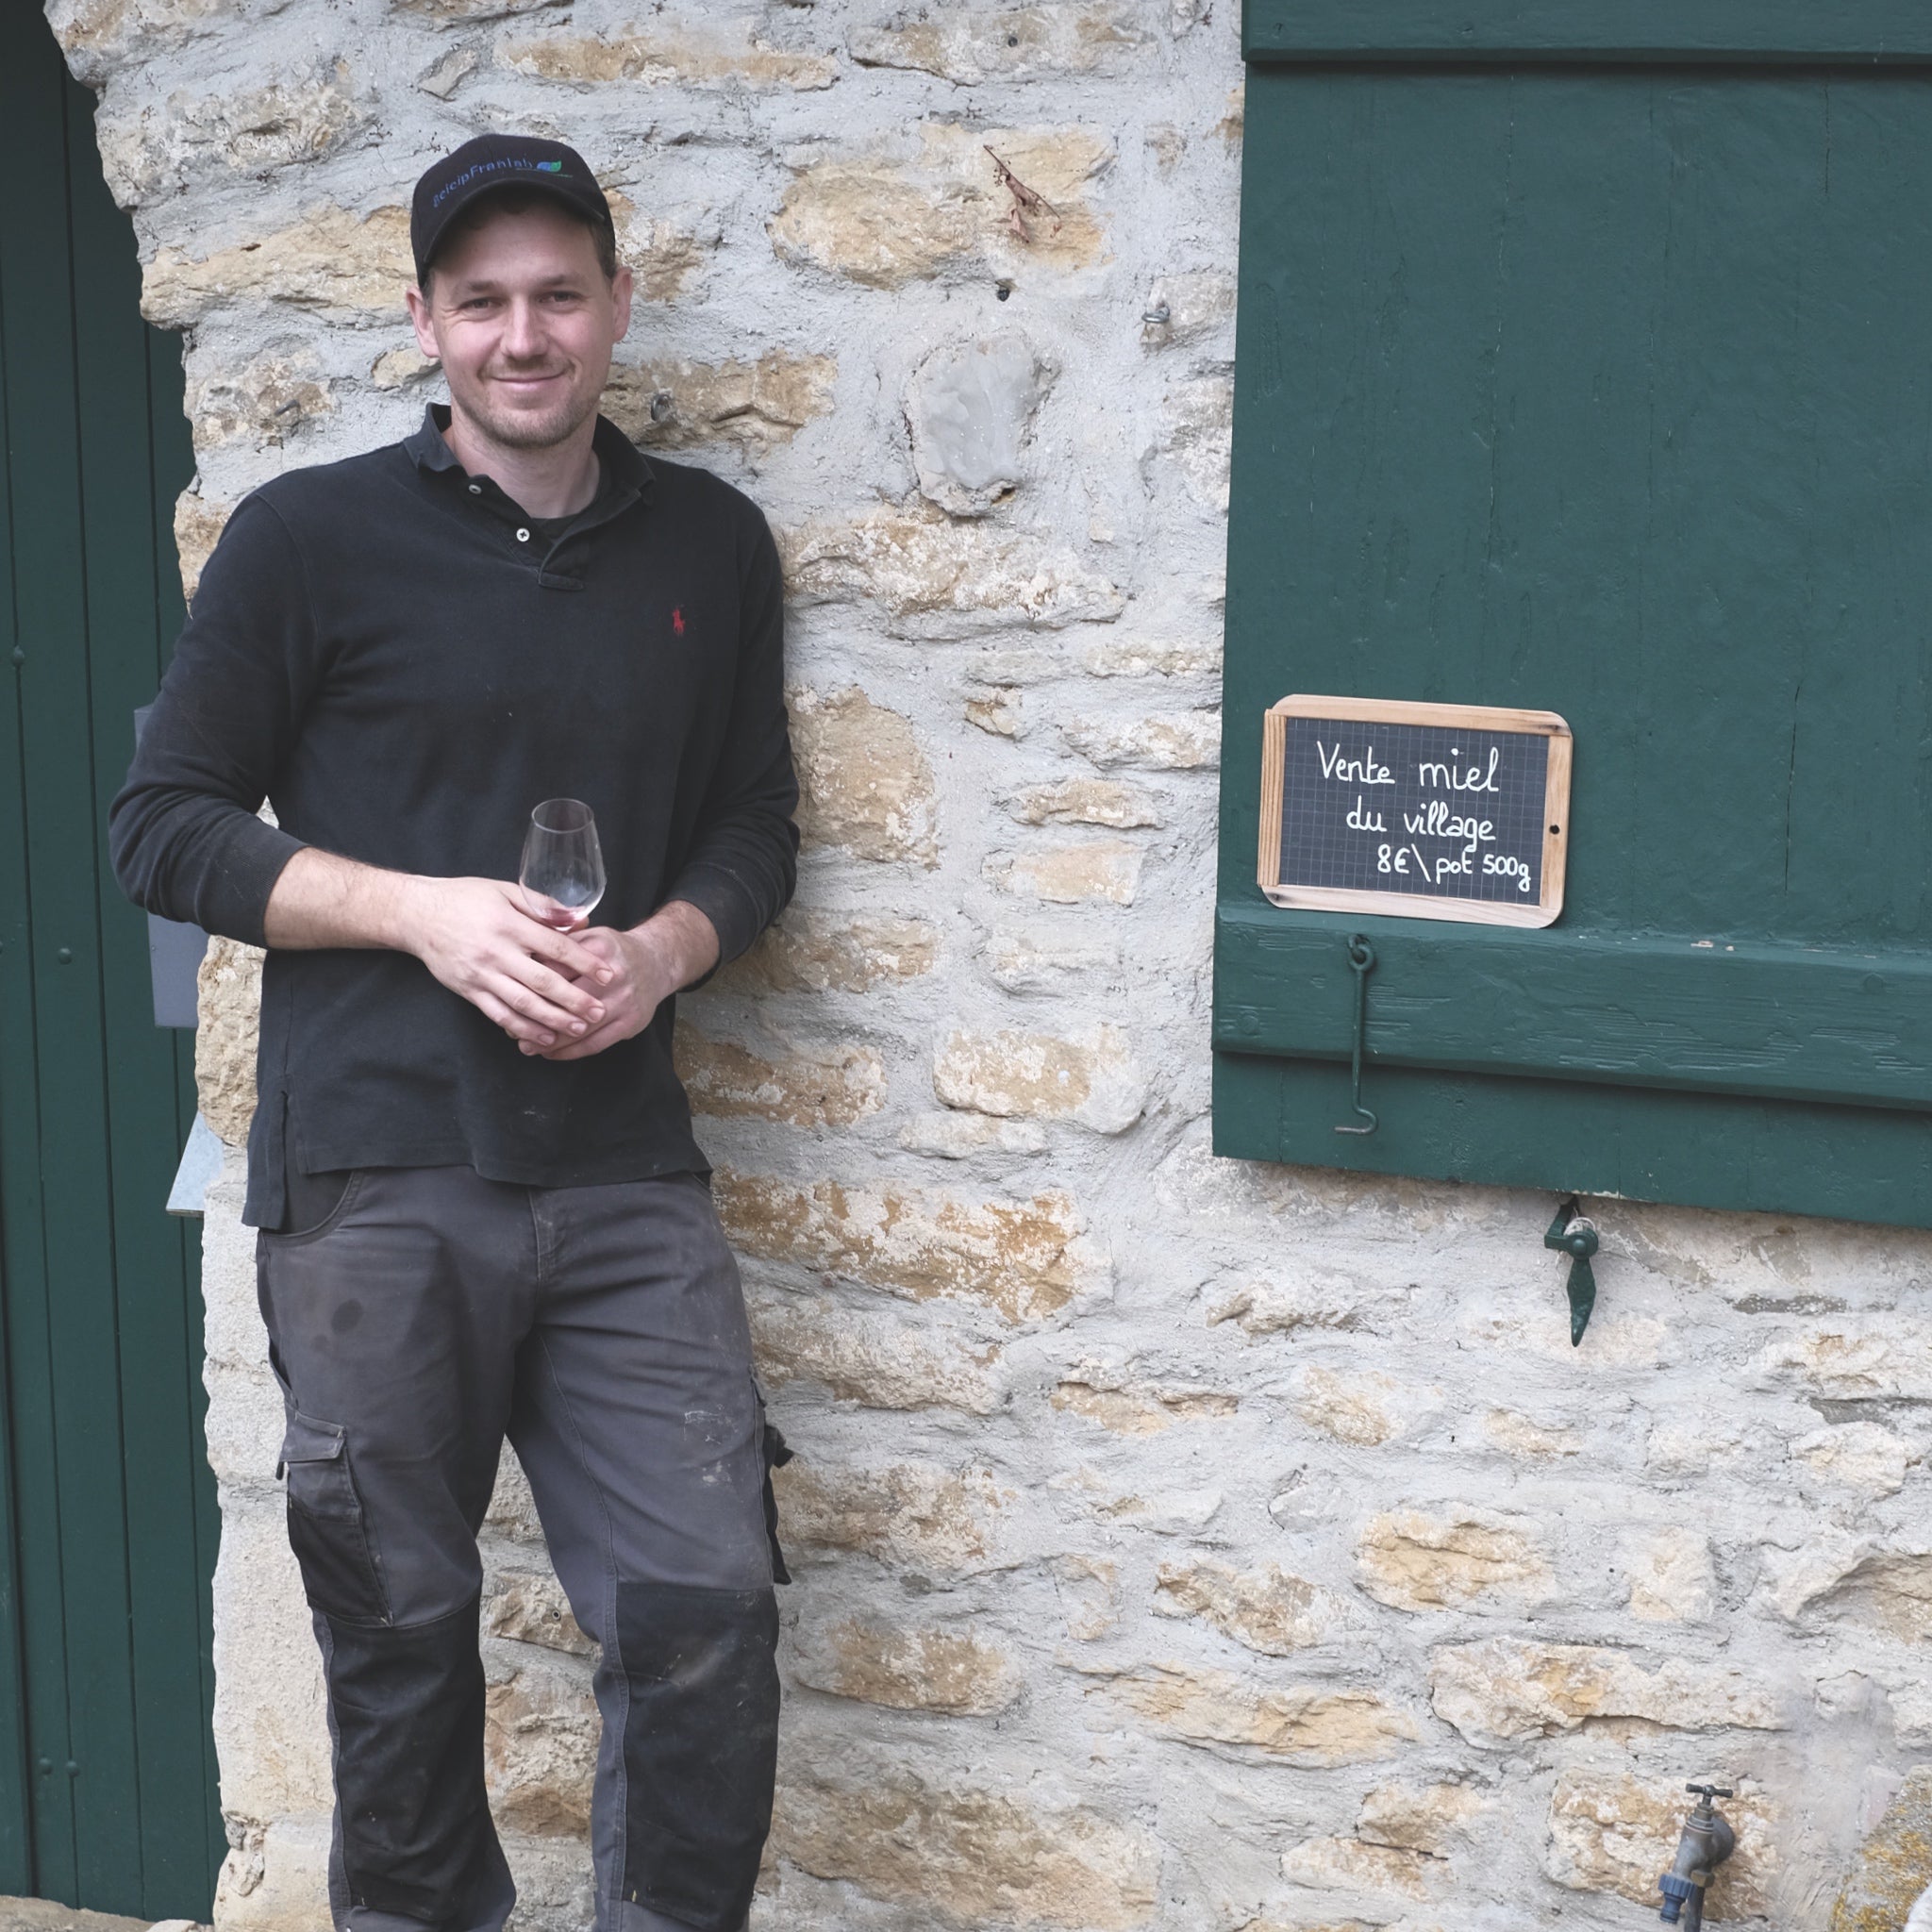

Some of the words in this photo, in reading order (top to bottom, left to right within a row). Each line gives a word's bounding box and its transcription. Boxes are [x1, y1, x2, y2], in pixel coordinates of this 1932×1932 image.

[1316, 741, 1395, 785] Vente
[1419, 746, 1499, 791] miel
[1346, 795, 1388, 832] du
[1404, 800, 1496, 853] village
[1482, 854, 1532, 892] 500g
